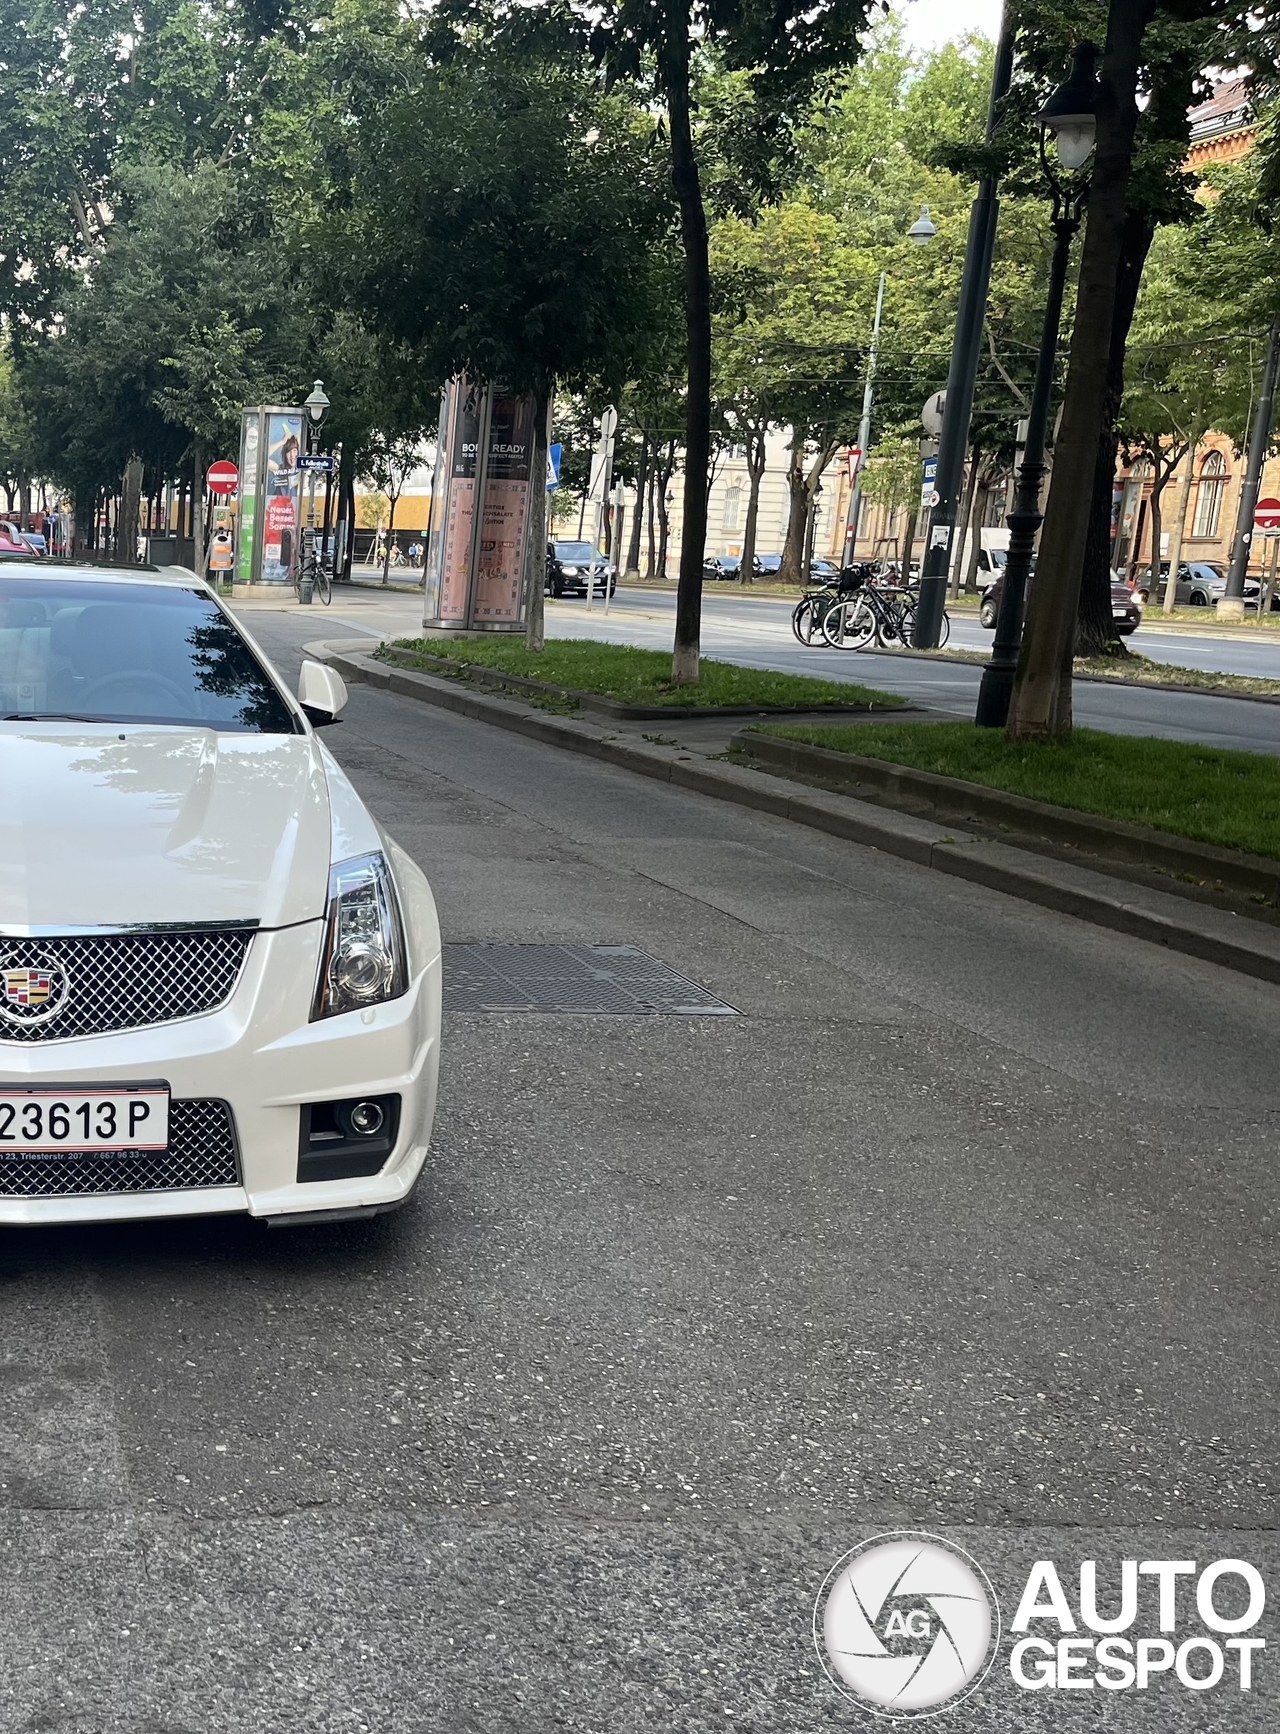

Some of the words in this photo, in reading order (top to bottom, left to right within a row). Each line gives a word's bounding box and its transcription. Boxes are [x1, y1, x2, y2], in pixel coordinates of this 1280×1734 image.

[492, 444, 526, 453] READY
[129, 1101, 150, 1137] P
[5, 1153, 18, 1161] 23,
[20, 1152, 66, 1160] Triesterstr.
[68, 1152, 84, 1160] 207
